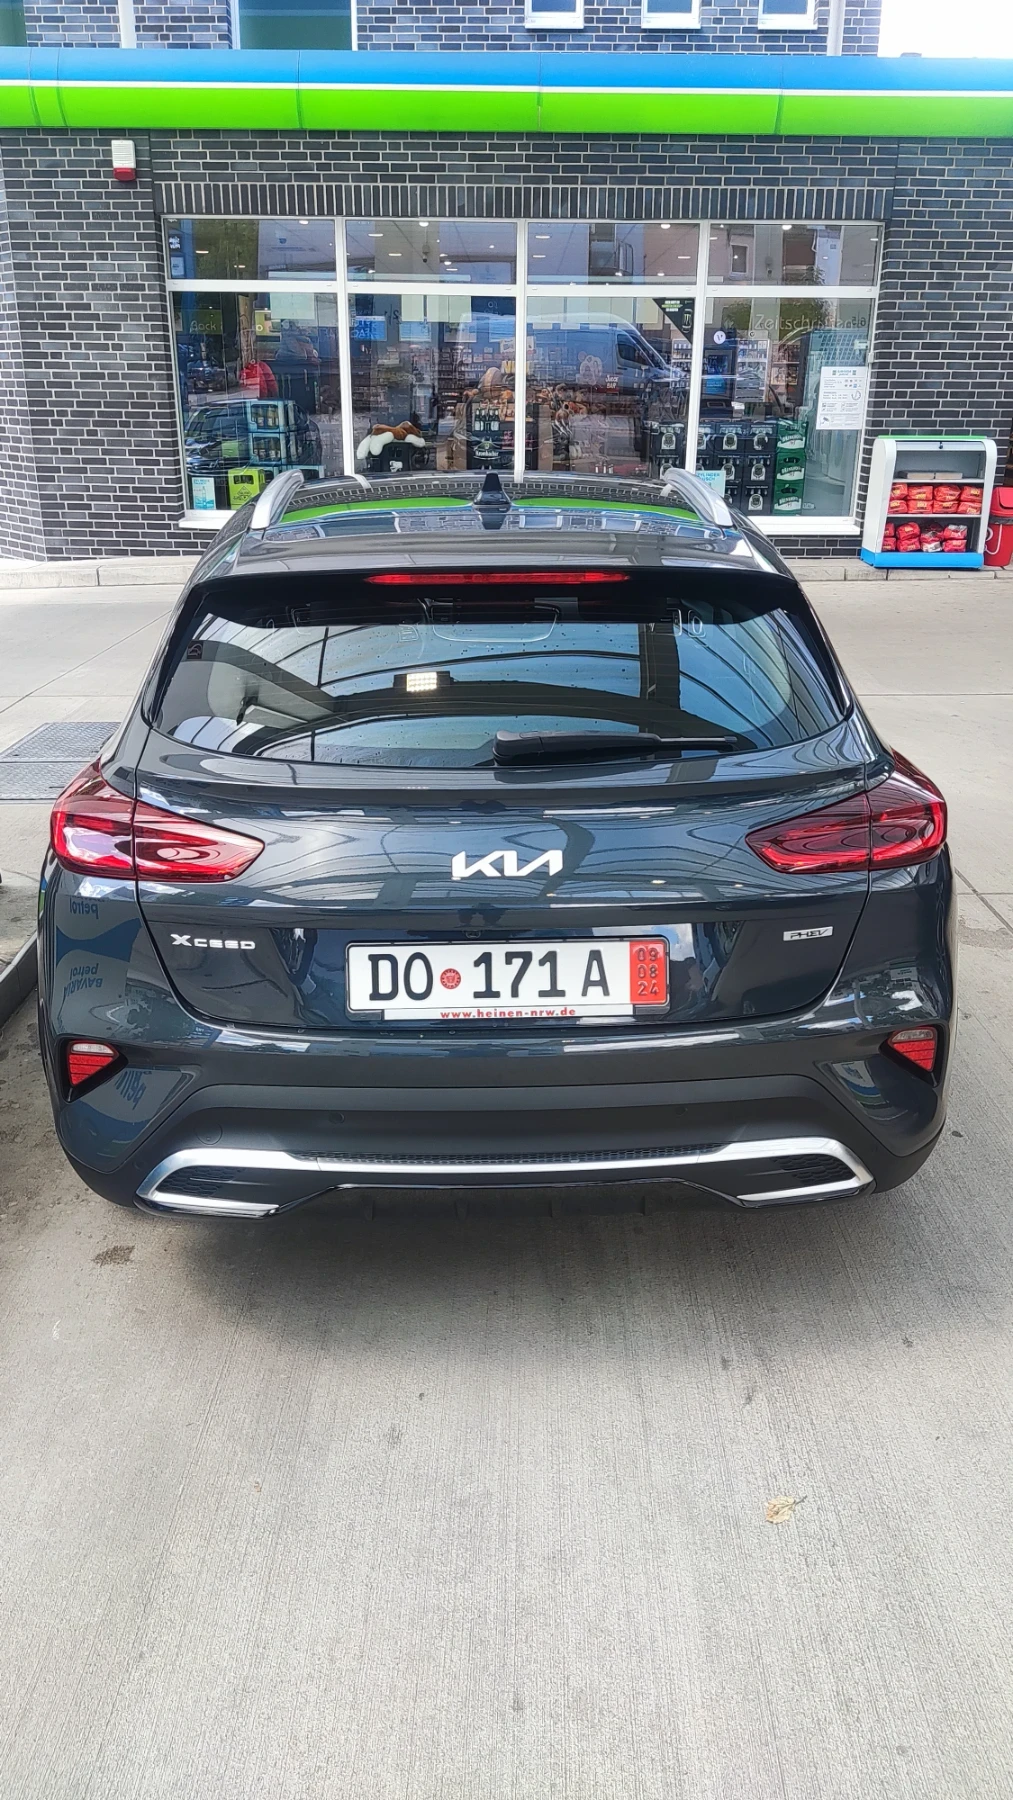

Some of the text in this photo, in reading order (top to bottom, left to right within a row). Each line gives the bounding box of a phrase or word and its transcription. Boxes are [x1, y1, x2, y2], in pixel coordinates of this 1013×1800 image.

[452, 849, 563, 877] KIA
[788, 928, 831, 940] PHEV
[636, 946, 659, 962] 09
[368, 951, 434, 1002] DO
[473, 950, 567, 999] 171
[581, 949, 610, 998] A
[637, 963, 659, 979] 08
[637, 980, 660, 997] 24
[440, 1007, 576, 1019] www.heinen-nrw.de
